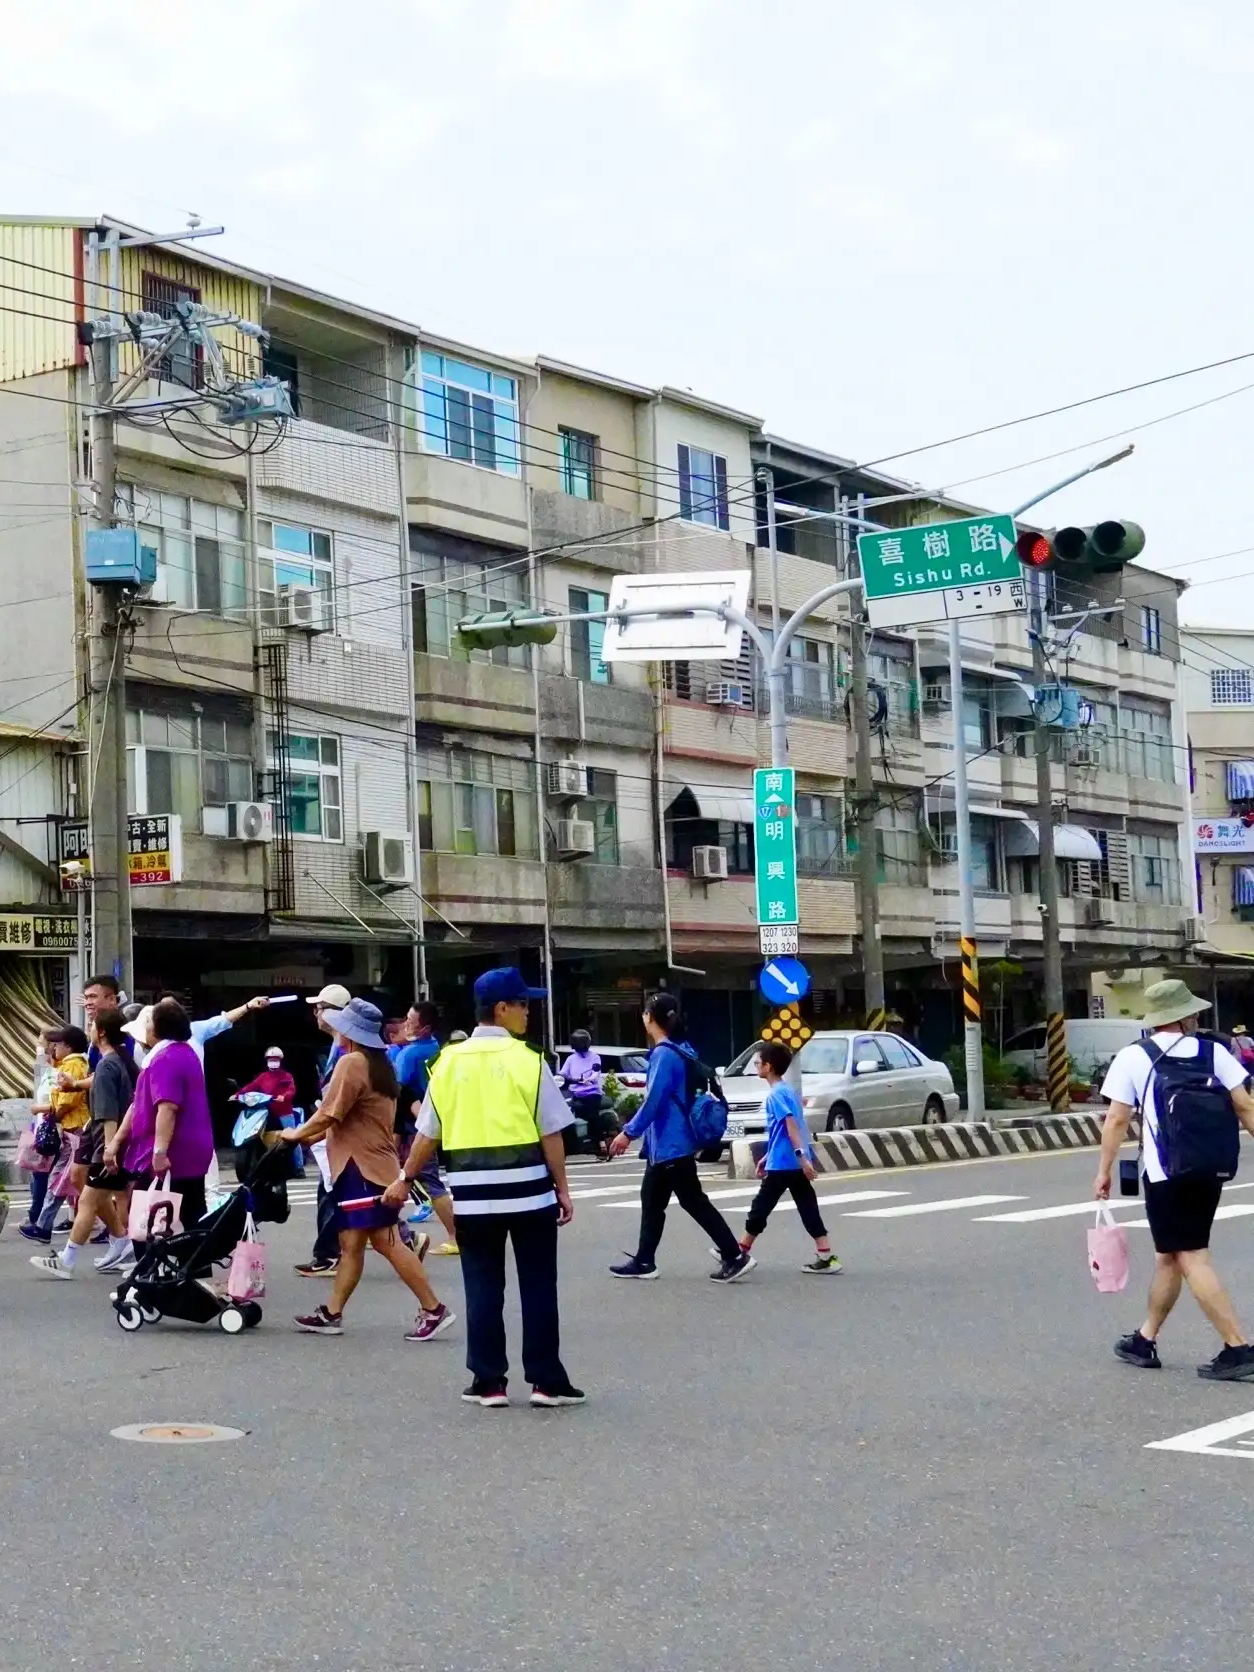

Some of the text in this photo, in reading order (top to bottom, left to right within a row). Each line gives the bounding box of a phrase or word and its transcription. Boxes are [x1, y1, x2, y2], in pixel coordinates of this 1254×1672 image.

[877, 524, 997, 566] 喜樹路
[894, 562, 992, 587] Sishu Rd.
[764, 773, 783, 792] 南
[765, 822, 787, 920] 明興路
[762, 942, 797, 953] 323 320
